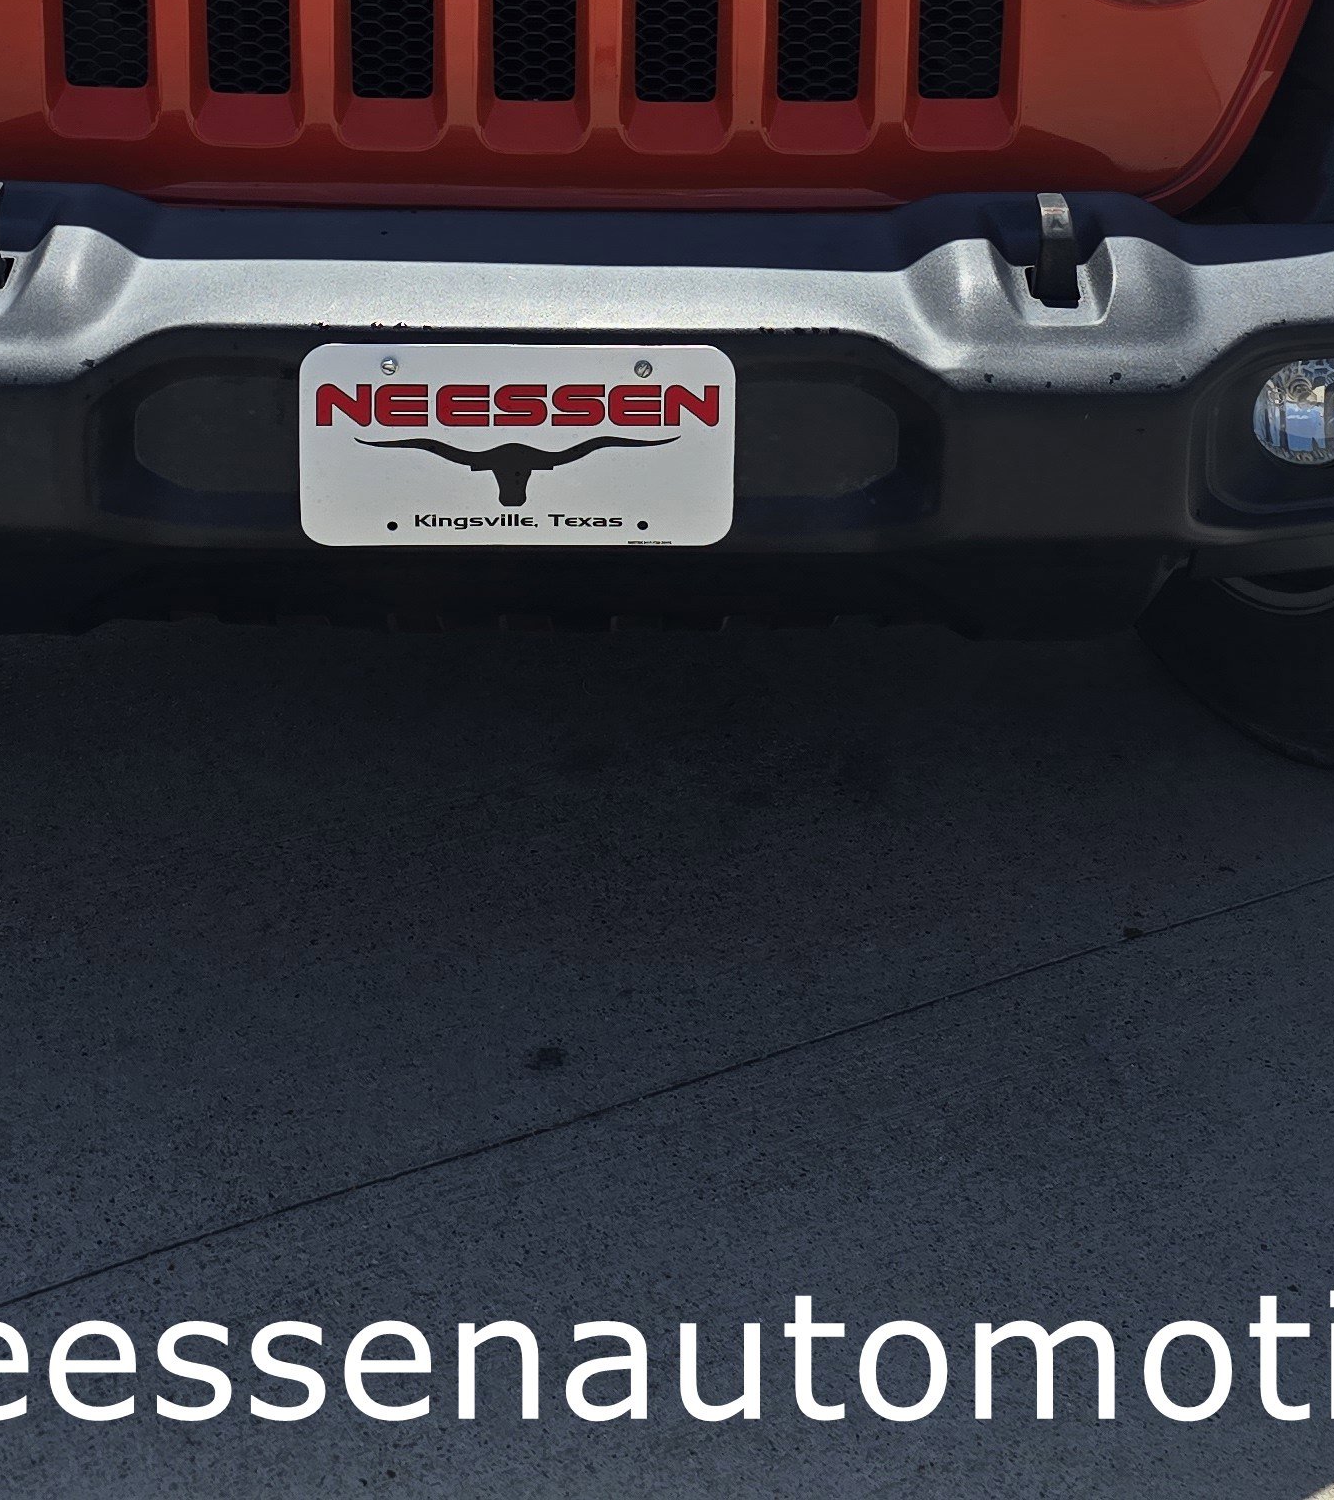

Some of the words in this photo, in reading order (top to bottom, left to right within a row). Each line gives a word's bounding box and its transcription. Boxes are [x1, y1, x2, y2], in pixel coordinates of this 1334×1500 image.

[315, 383, 720, 427] NEESSEN
[414, 513, 539, 530] Kingsville,
[547, 513, 623, 528] Texas
